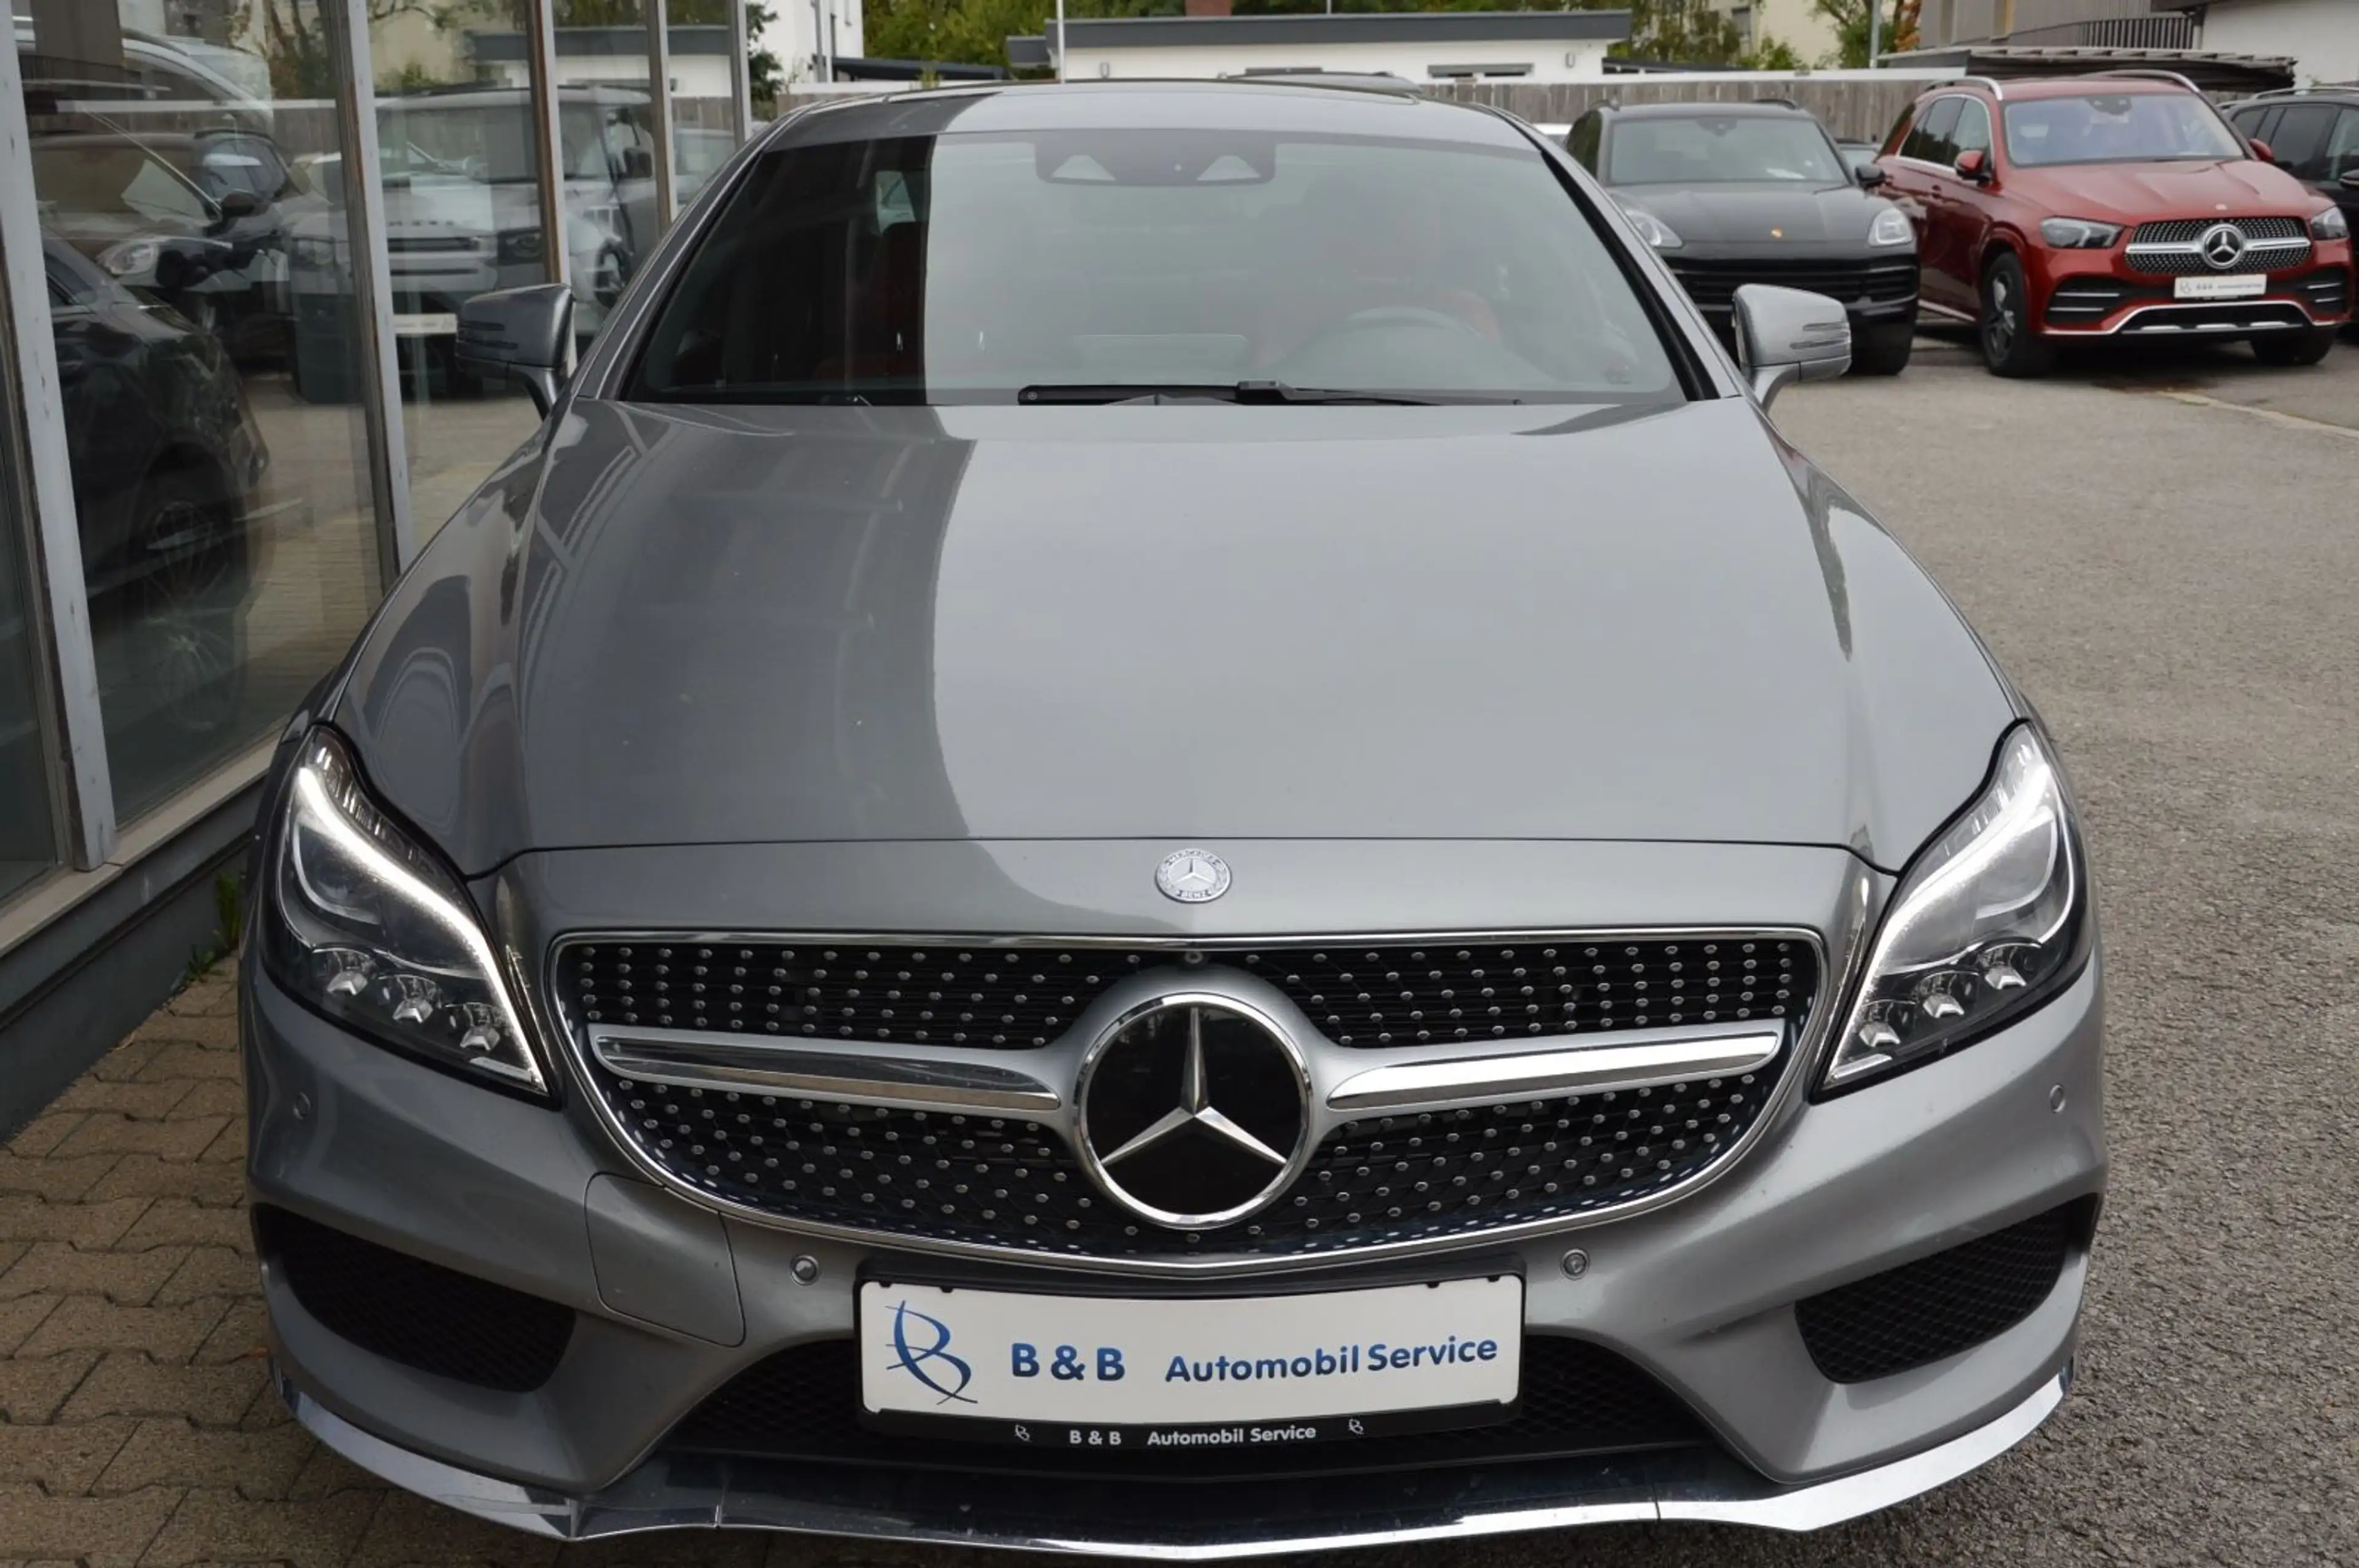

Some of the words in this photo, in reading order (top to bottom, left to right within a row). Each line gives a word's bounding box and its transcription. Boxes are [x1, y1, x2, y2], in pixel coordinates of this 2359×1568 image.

[1011, 1342, 1041, 1378] B
[1050, 1344, 1087, 1381] &
[1096, 1346, 1126, 1383] B
[1164, 1344, 1359, 1383] Automobil
[1366, 1335, 1499, 1372] Service
[1069, 1429, 1082, 1445] B
[1088, 1430, 1103, 1445] &
[1109, 1430, 1122, 1446] B
[1146, 1428, 1244, 1446] Automobil
[1250, 1424, 1317, 1443] Service
